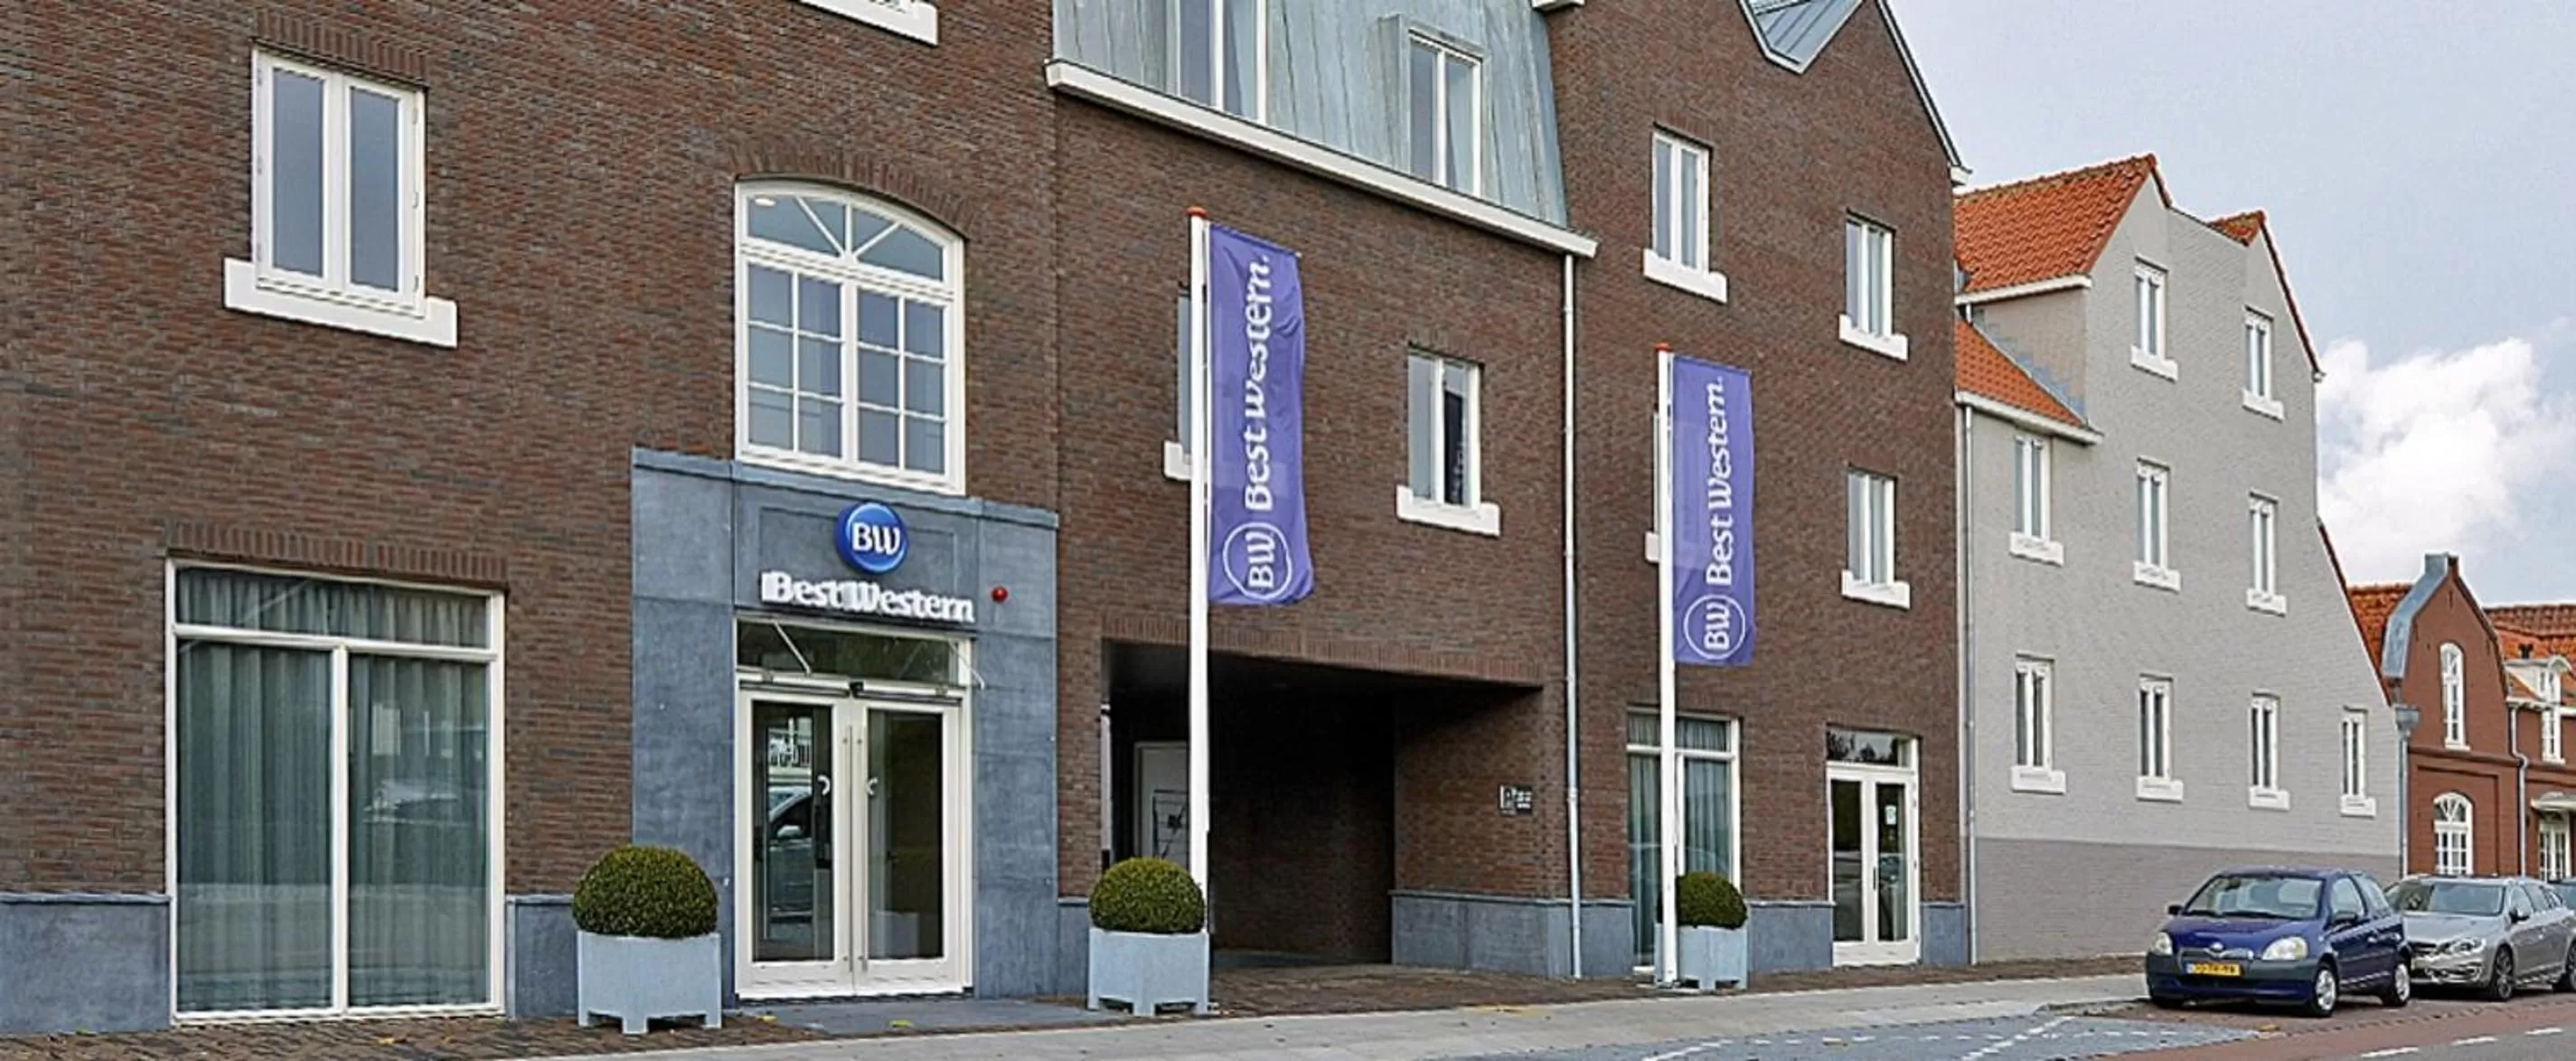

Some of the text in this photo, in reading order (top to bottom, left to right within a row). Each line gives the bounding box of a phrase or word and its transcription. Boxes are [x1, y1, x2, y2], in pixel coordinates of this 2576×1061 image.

[1245, 424, 1274, 512] Best
[851, 522, 900, 555] BW
[1246, 528, 1274, 589] BW
[1706, 513, 1733, 586] Best
[760, 571, 974, 623] Best Western
[1704, 602, 1731, 651] BW
